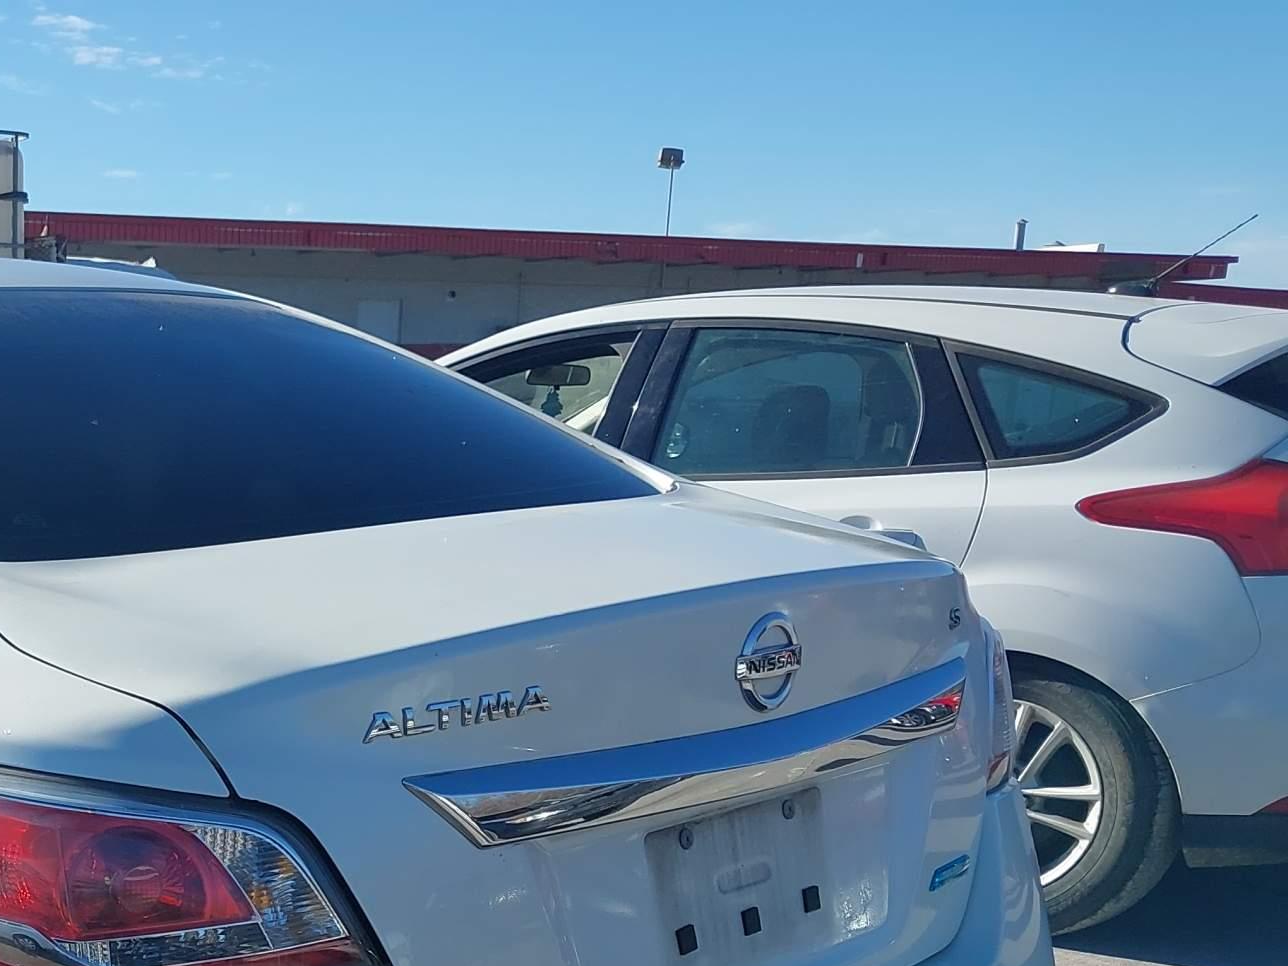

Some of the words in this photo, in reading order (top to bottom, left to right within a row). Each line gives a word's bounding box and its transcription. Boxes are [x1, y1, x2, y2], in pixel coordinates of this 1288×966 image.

[949, 607, 961, 630] S
[746, 649, 800, 675] NISSAN
[362, 685, 550, 744] ALTIMA
